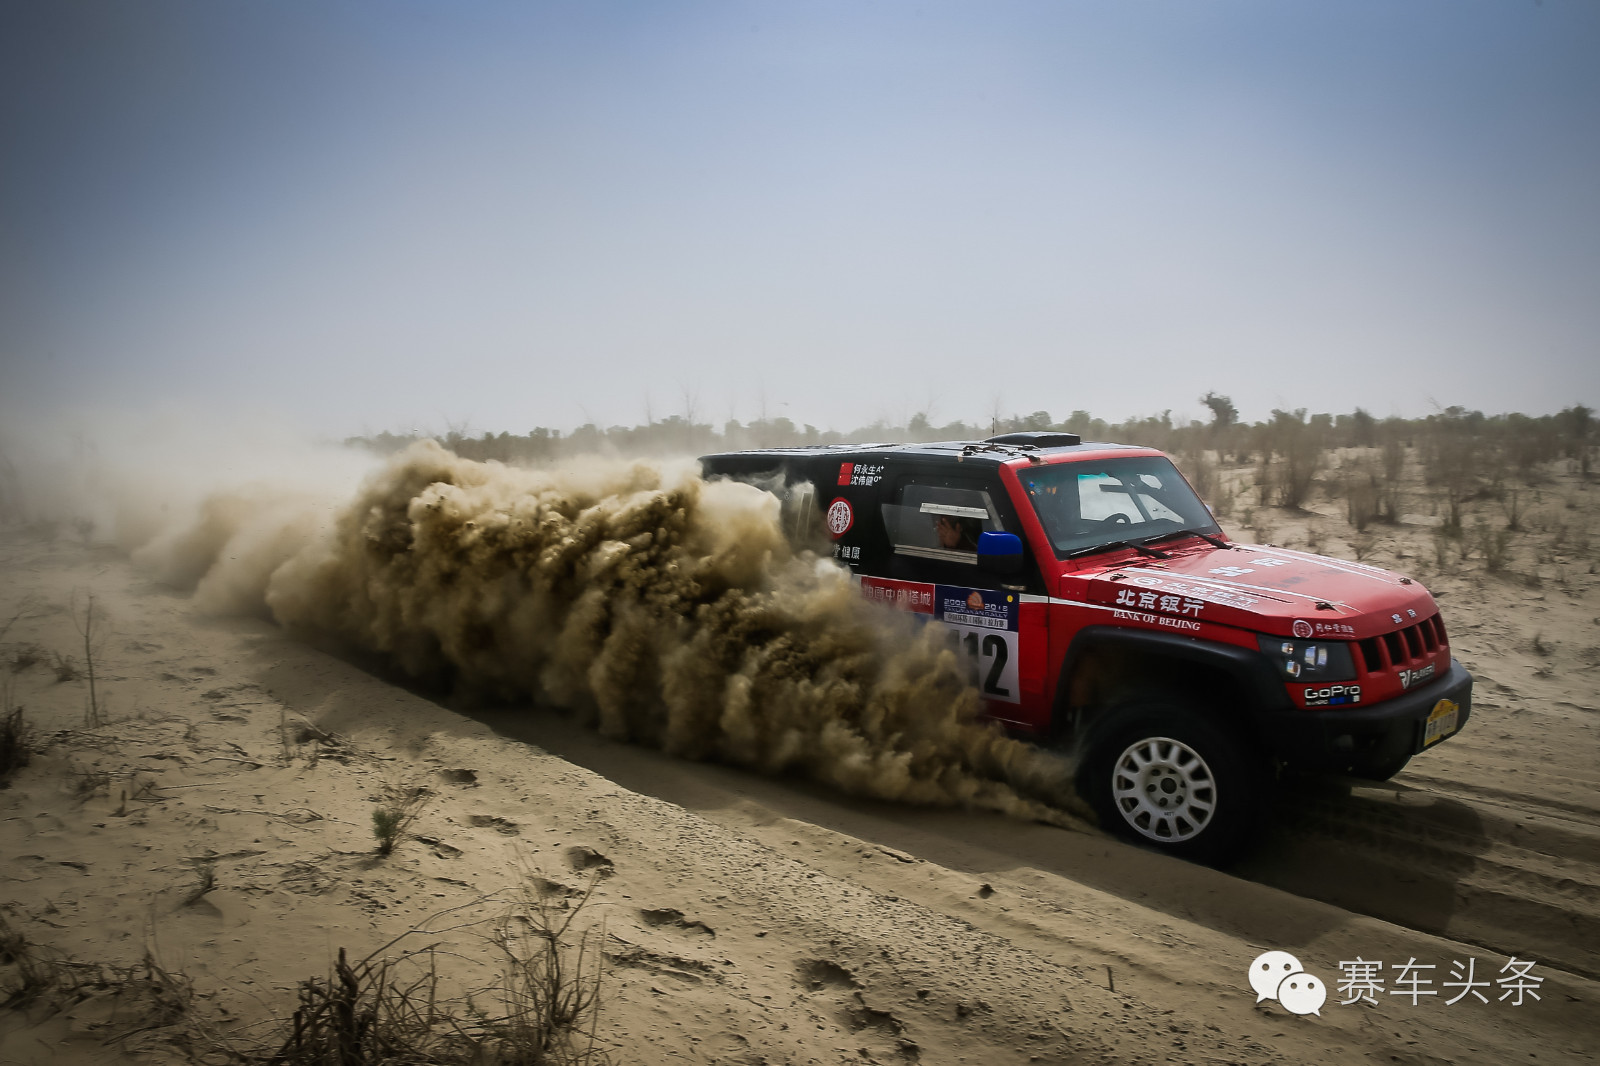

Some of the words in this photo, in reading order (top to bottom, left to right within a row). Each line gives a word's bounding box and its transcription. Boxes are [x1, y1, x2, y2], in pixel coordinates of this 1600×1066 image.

[1116, 589, 1205, 617] 北京银行
[1113, 610, 1140, 621] BANK
[1143, 613, 1158, 624] OF
[1159, 617, 1201, 631] BEIJING
[1304, 685, 1361, 699] GoPro
